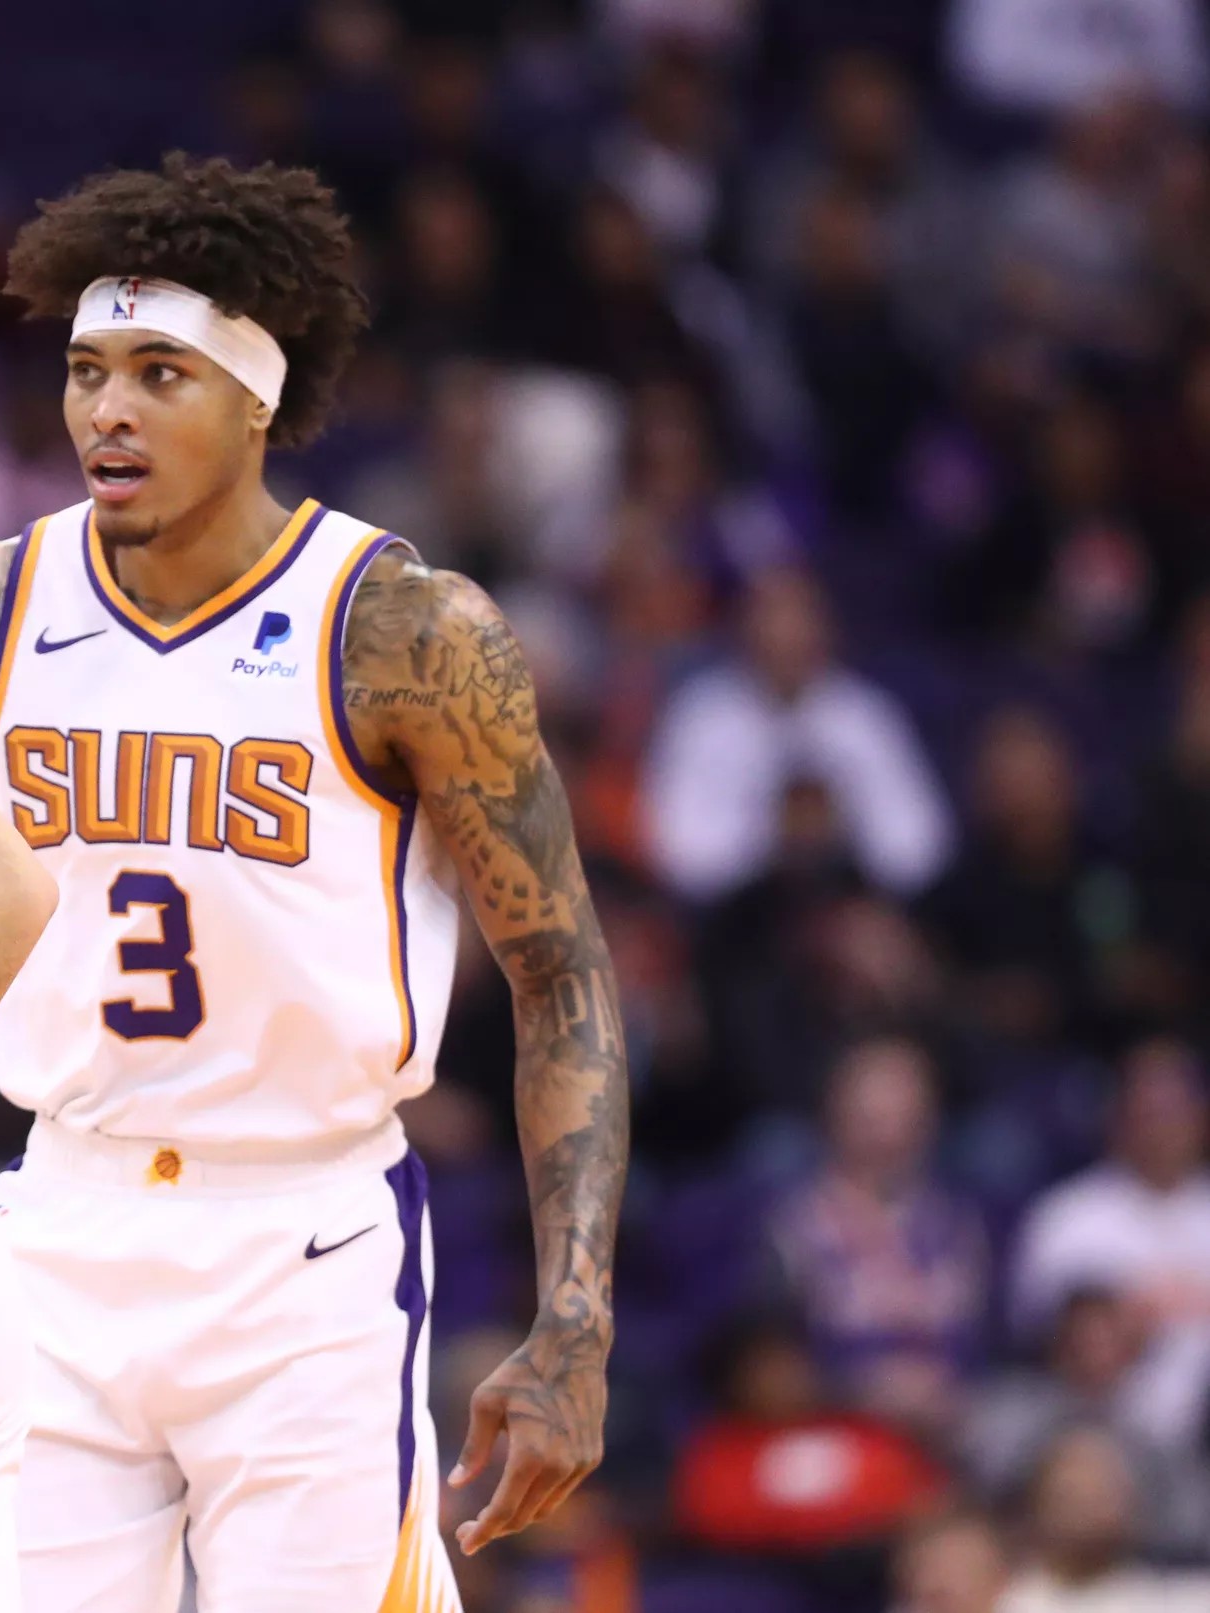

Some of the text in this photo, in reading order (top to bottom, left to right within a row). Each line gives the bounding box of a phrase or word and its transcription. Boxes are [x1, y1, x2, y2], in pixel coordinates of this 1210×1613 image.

[231, 658, 298, 678] PayPal
[5, 725, 314, 867] SUNS
[101, 868, 207, 1043] 3
